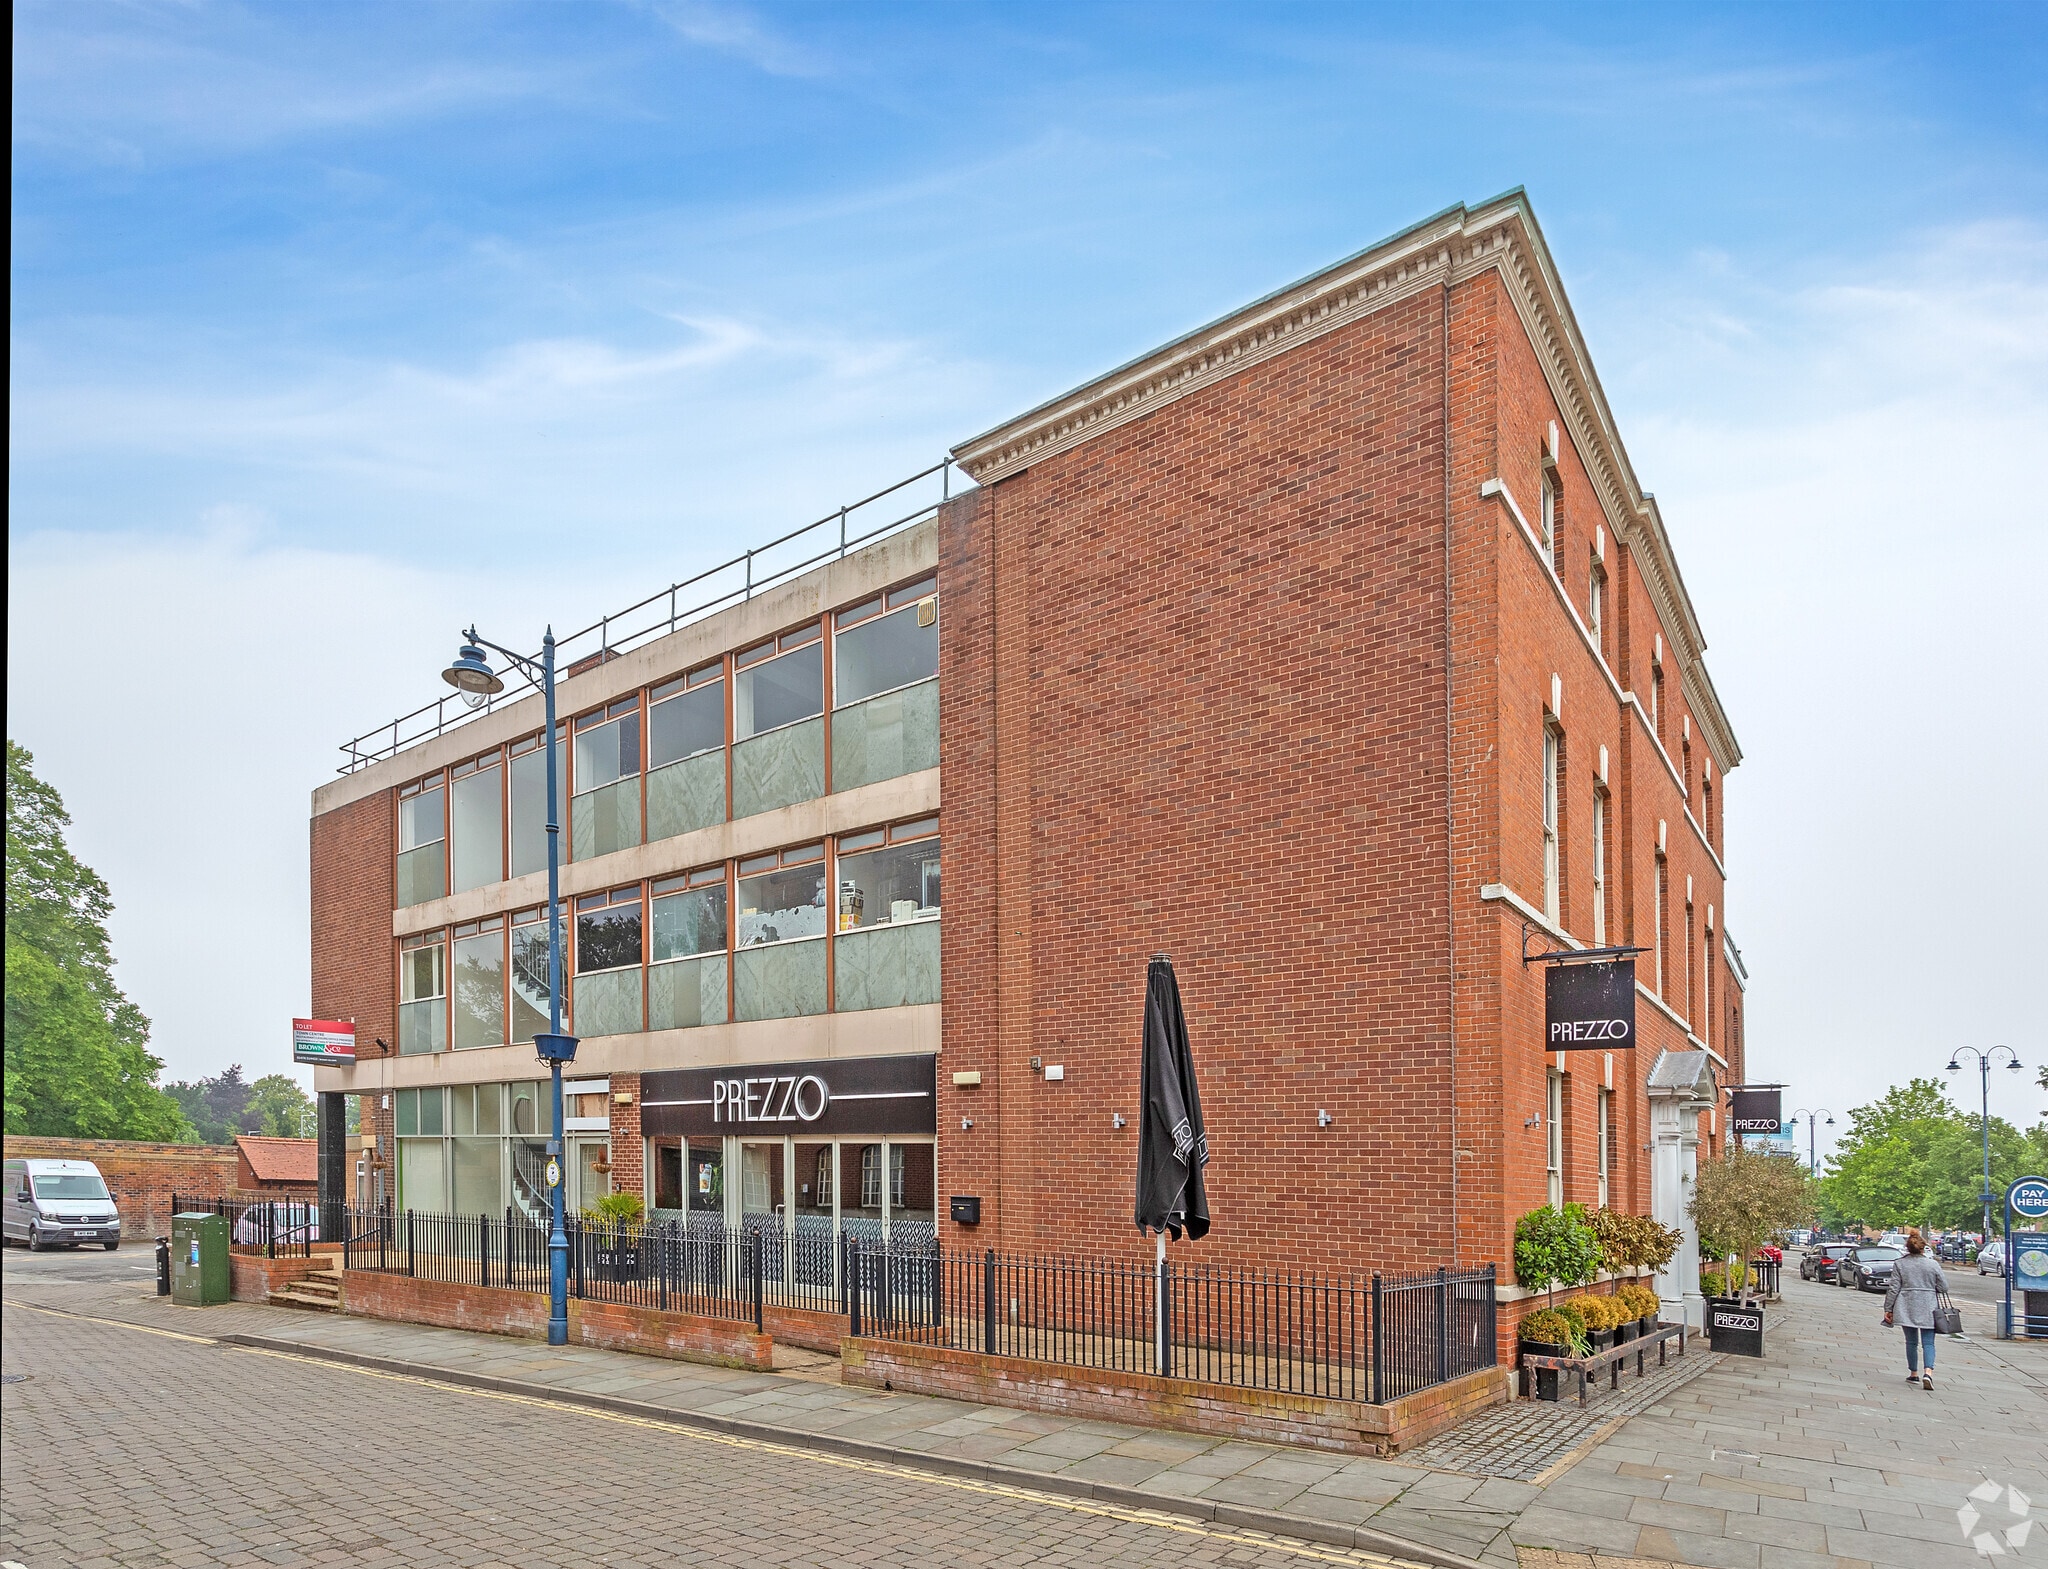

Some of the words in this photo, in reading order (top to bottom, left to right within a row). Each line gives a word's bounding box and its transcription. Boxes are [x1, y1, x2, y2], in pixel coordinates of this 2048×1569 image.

[1551, 1019, 1629, 1042] PREZZO
[713, 1075, 829, 1122] PREZZO
[1736, 1120, 1778, 1130] PREZZO
[2022, 1190, 2045, 1198] PAY
[2016, 1198, 2048, 1206] HERE
[1716, 1314, 1757, 1328] PREZZO
